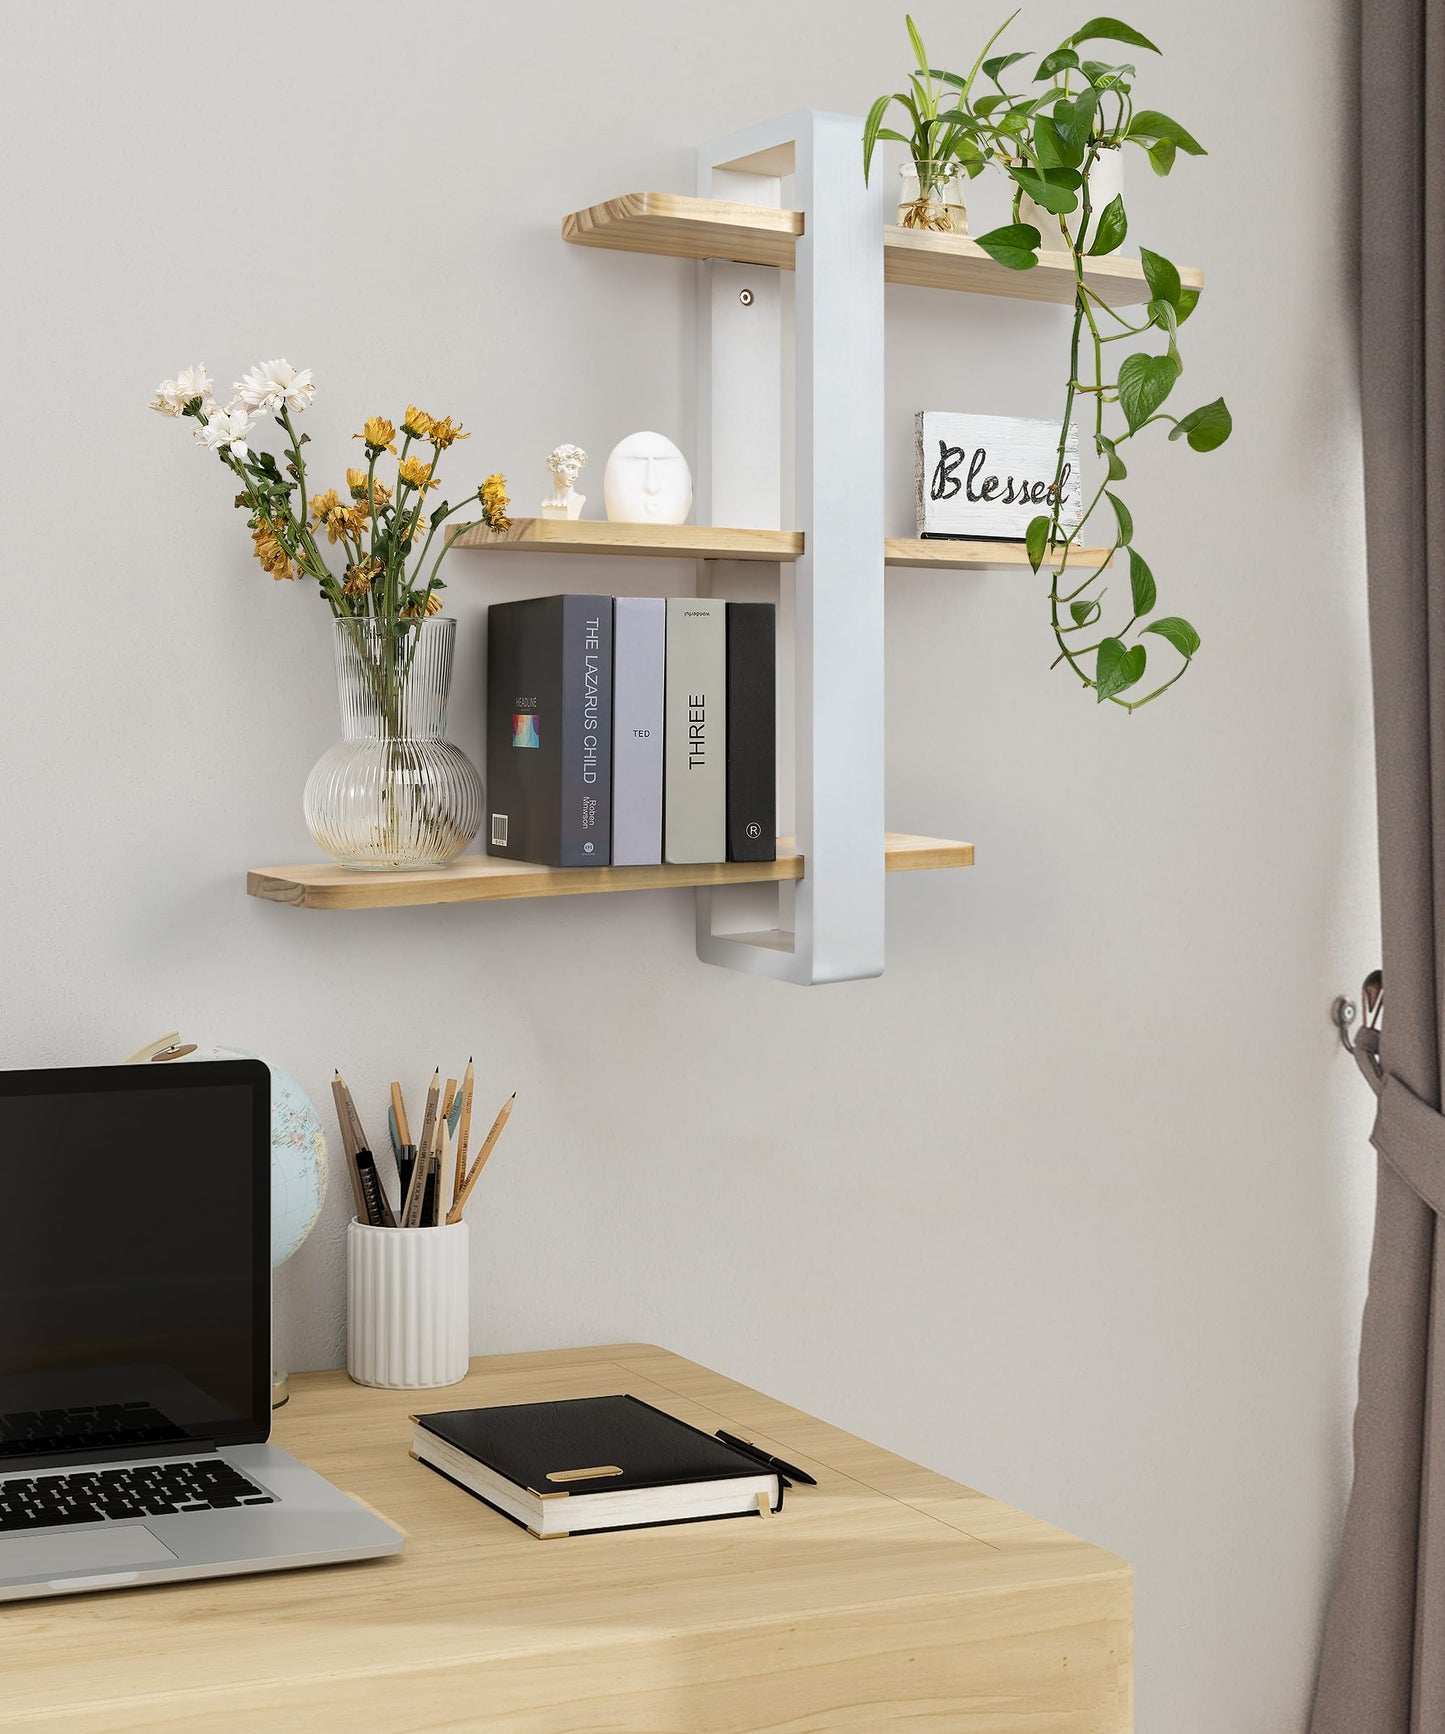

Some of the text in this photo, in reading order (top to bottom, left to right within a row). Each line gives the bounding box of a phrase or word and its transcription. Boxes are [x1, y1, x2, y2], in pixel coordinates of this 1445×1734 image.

[930, 439, 1072, 506] Blessed
[583, 617, 599, 784] THE LAZARUS CHILD
[633, 729, 650, 738] TED
[688, 694, 705, 770] THREE
